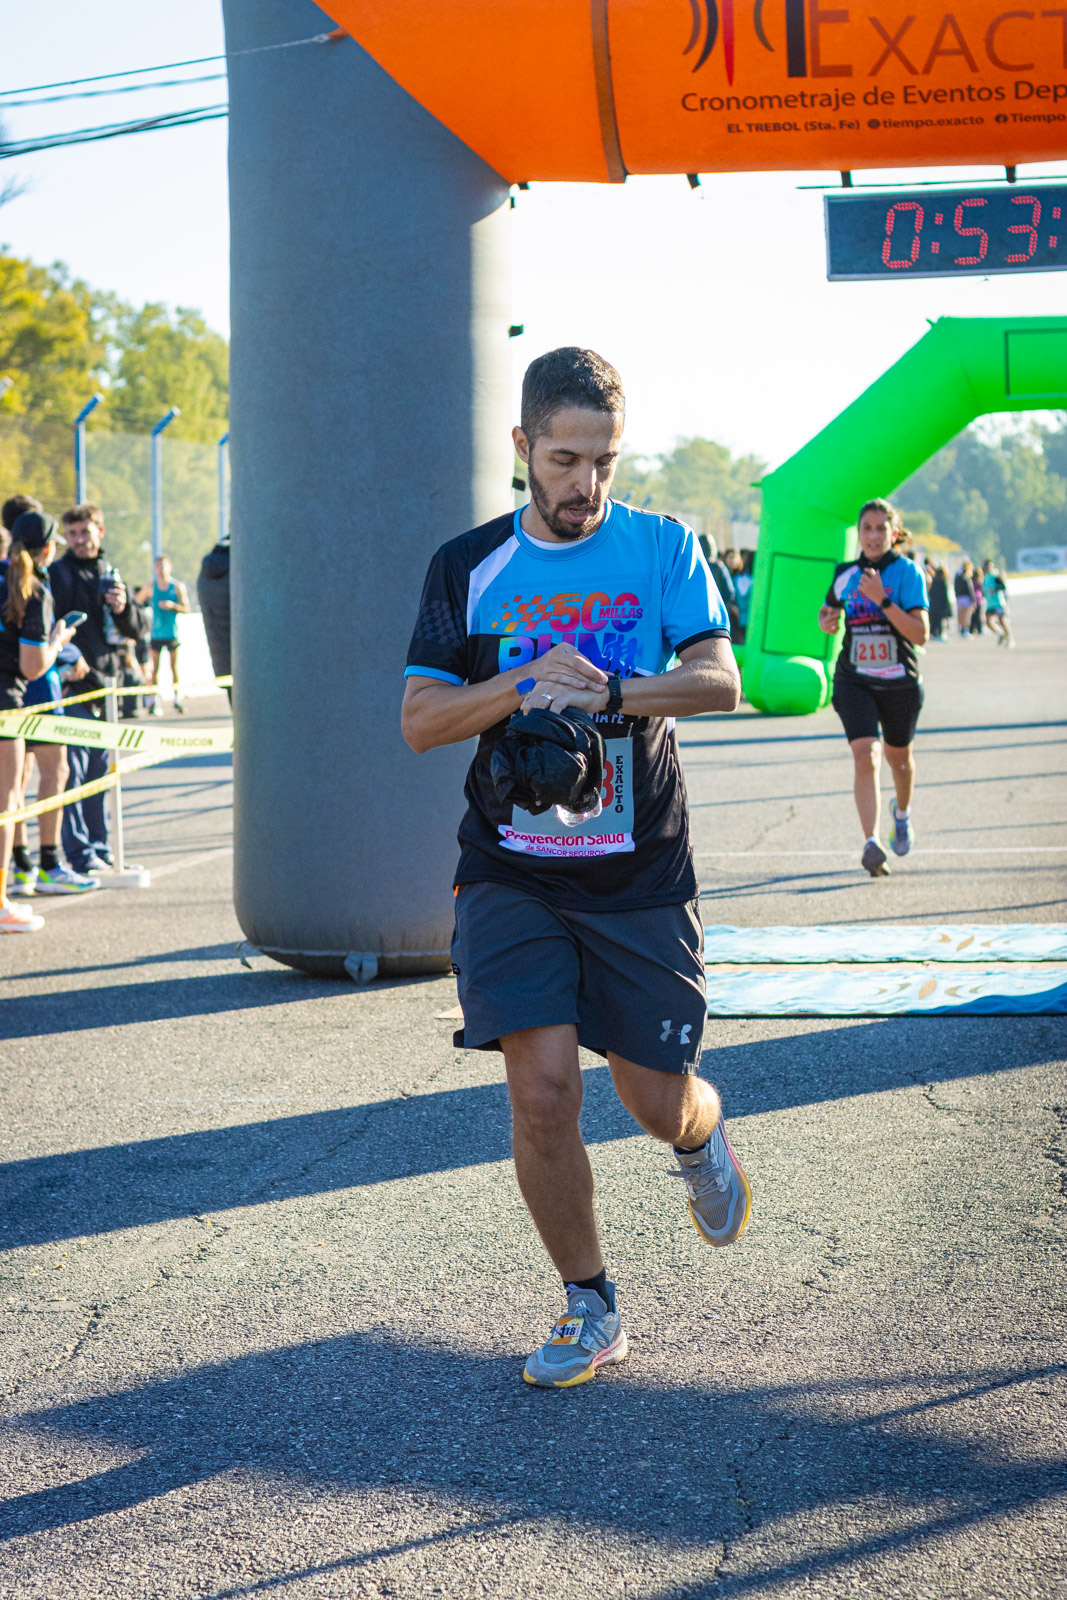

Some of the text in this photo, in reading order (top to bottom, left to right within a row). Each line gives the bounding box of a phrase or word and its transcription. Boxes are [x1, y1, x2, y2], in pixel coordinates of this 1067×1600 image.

[681, 80, 1067, 112] Cronometraje de Eventos Dep
[727, 123, 743, 134] EL
[746, 121, 802, 133] TREBOL
[804, 120, 836, 132] (Sta.
[838, 119, 861, 131] Fe)
[882, 115, 985, 129] tiempo.exacto
[598, 607, 643, 619] MILLAS
[858, 642, 888, 661] 213
[53, 725, 214, 747] PRECAUCION PRECAUCION
[614, 755, 624, 814] EXACTO
[535, 845, 567, 857] SANCOR
